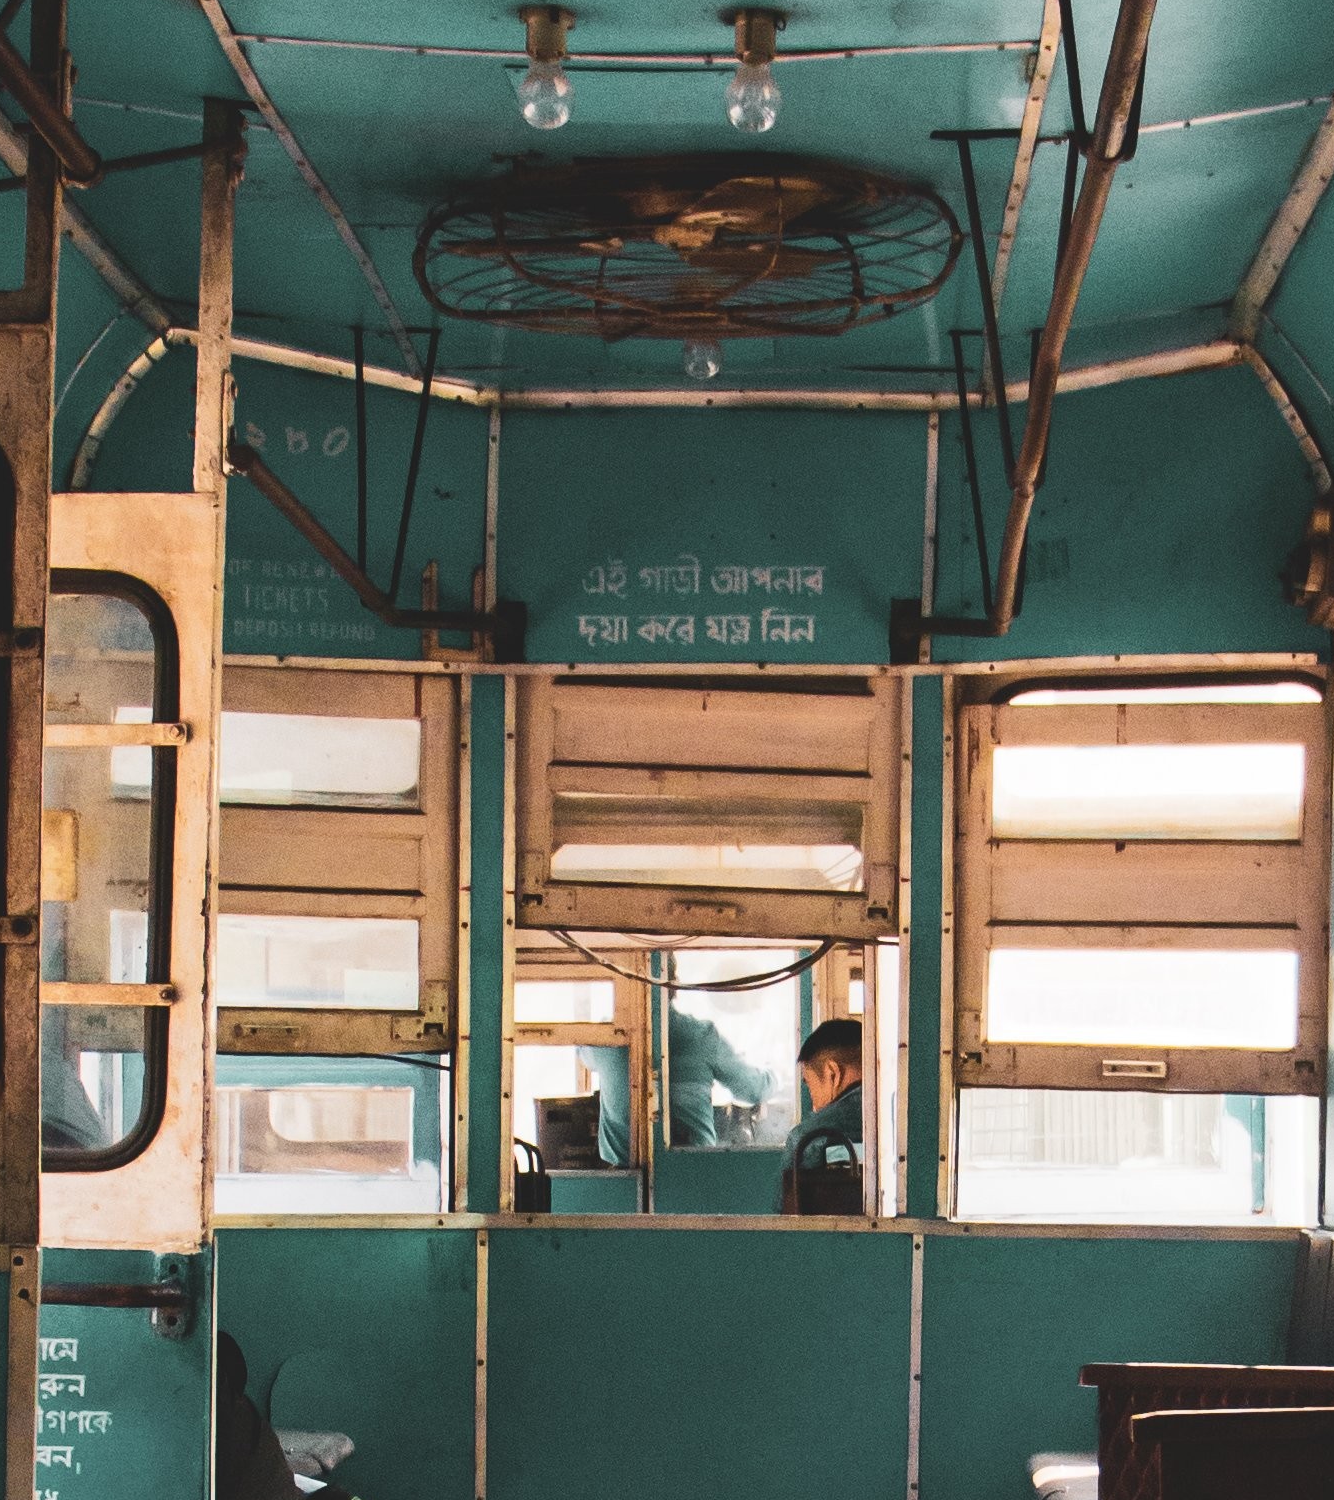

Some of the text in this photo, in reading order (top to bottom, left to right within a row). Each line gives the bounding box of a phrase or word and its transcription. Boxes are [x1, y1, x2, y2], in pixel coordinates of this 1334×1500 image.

[582, 557, 627, 599] এই
[711, 565, 827, 598] আপনার
[637, 614, 695, 646] করে
[705, 613, 751, 646] যত্ন
[760, 606, 816, 644] নিন
[38, 1337, 78, 1362] ামে
[38, 1373, 86, 1400] রুন
